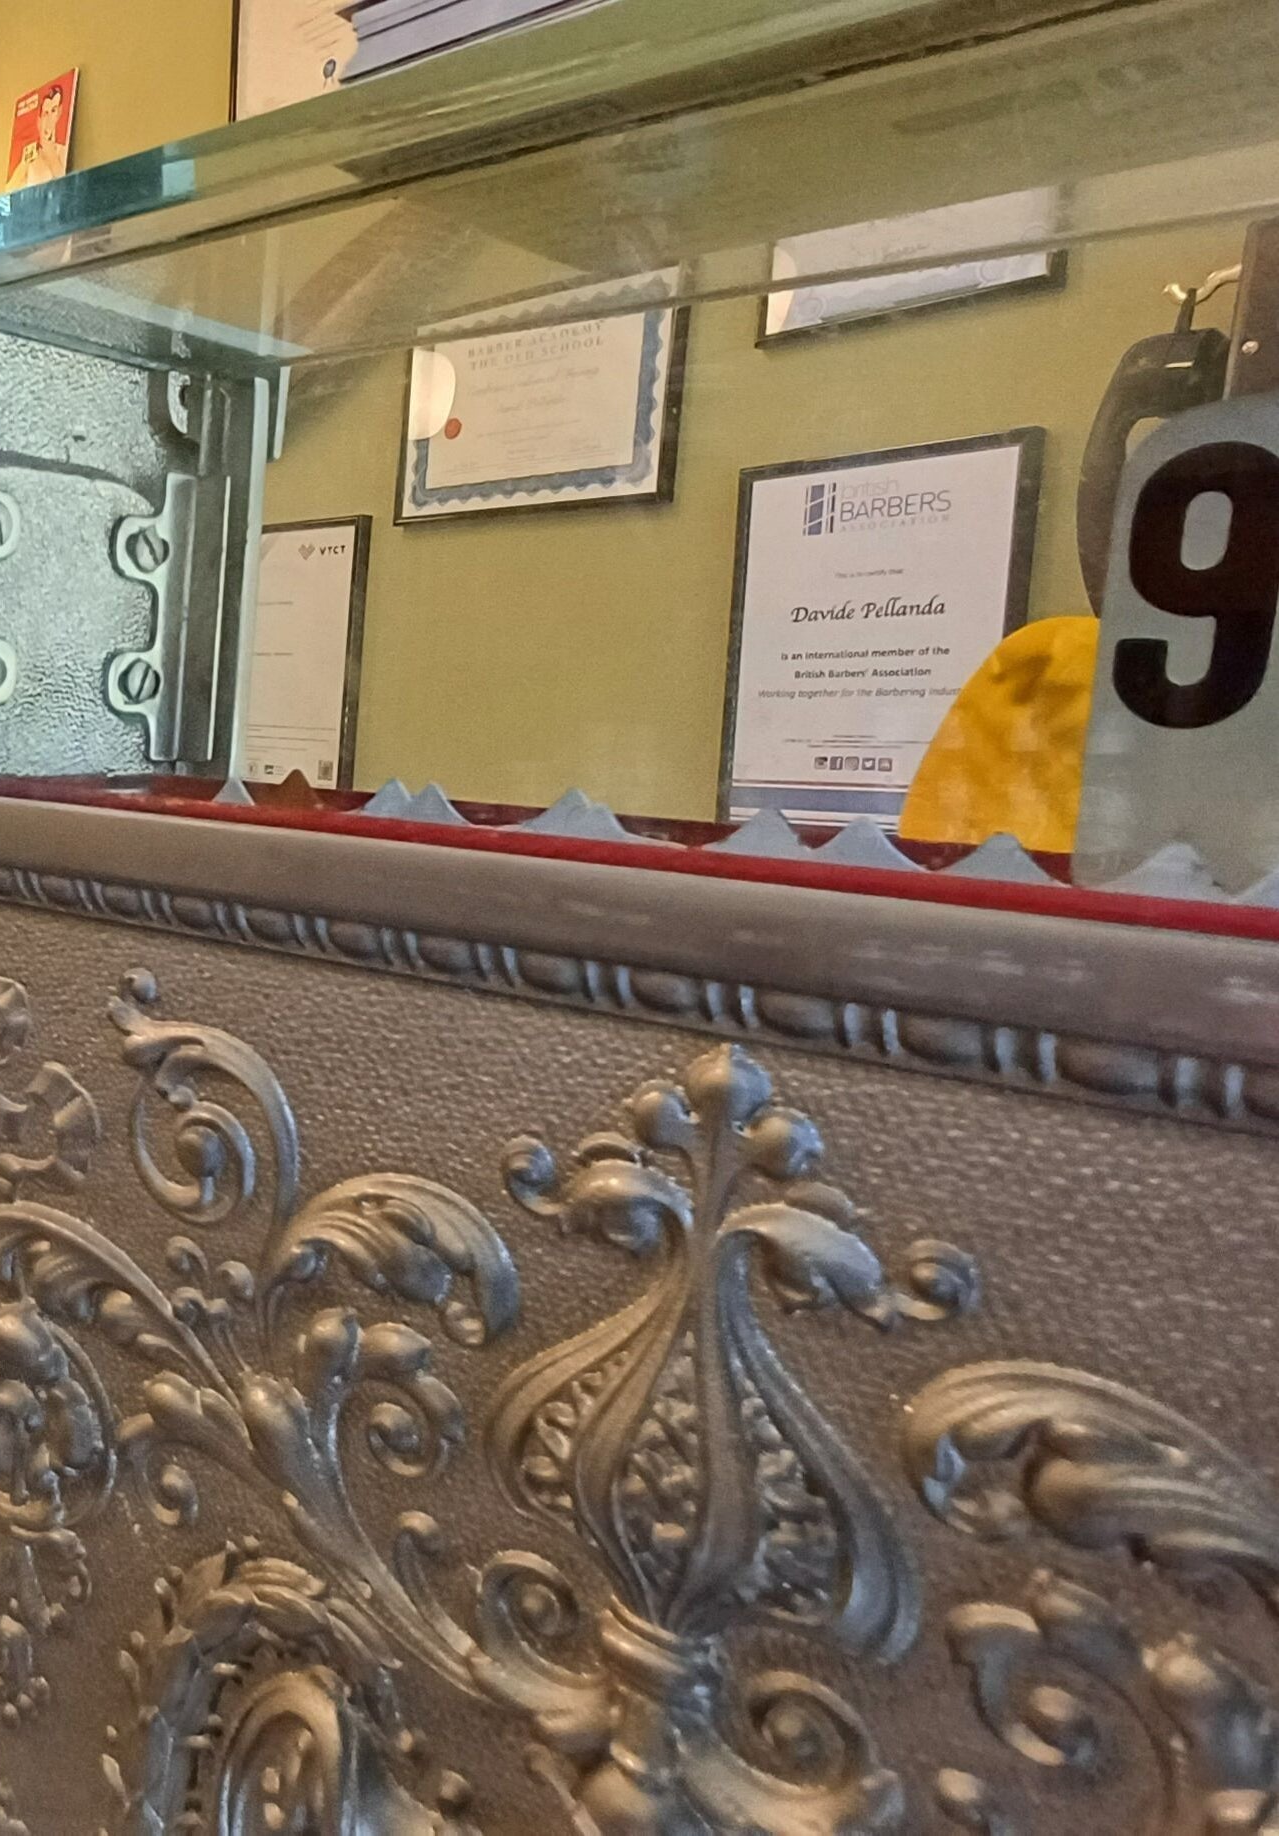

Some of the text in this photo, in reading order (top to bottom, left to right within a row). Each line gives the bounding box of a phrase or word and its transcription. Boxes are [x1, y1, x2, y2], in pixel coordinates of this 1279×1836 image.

[839, 490, 952, 522] BARBERS
[319, 544, 347, 556] VTCT
[1112, 441, 1279, 729] 9
[790, 594, 946, 623] Davide Pellanda
[791, 652, 803, 661] an
[871, 647, 915, 658] member
[918, 646, 930, 656] of
[932, 646, 950, 656] the
[794, 669, 826, 679] British
[871, 667, 932, 678] Association
[797, 688, 838, 699] together
